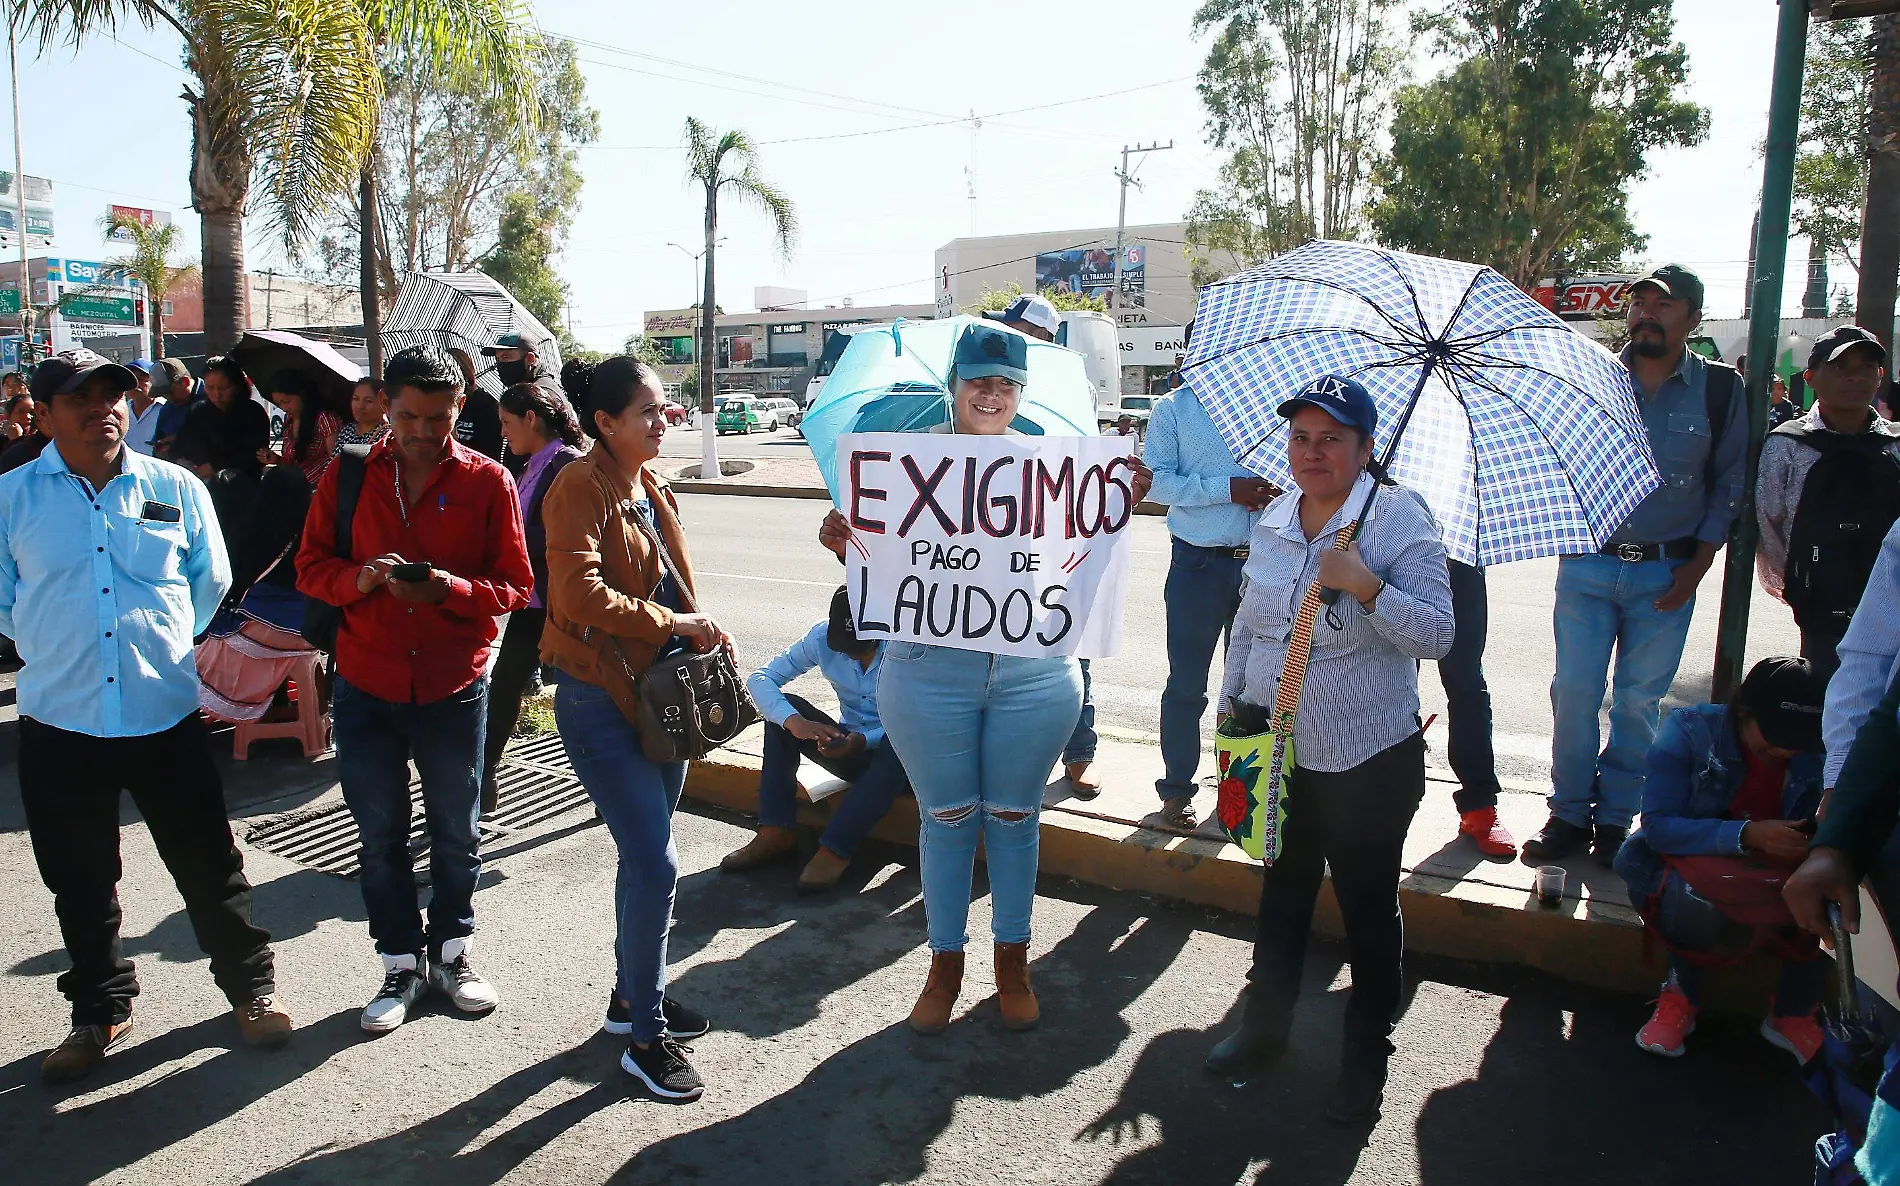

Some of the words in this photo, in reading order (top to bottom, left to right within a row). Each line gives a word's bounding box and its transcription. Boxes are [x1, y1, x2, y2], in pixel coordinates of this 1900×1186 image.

[1090, 272, 1114, 280] TRABAJO
[67, 308, 76, 316] EL
[81, 310, 119, 319] MEZQUITAL
[70, 323, 105, 331] BARNICES
[850, 451, 1132, 539] EXIGIMOS
[911, 539, 981, 571] PAGO
[1009, 551, 1041, 573] DE
[858, 566, 1072, 647] LAUDOS
